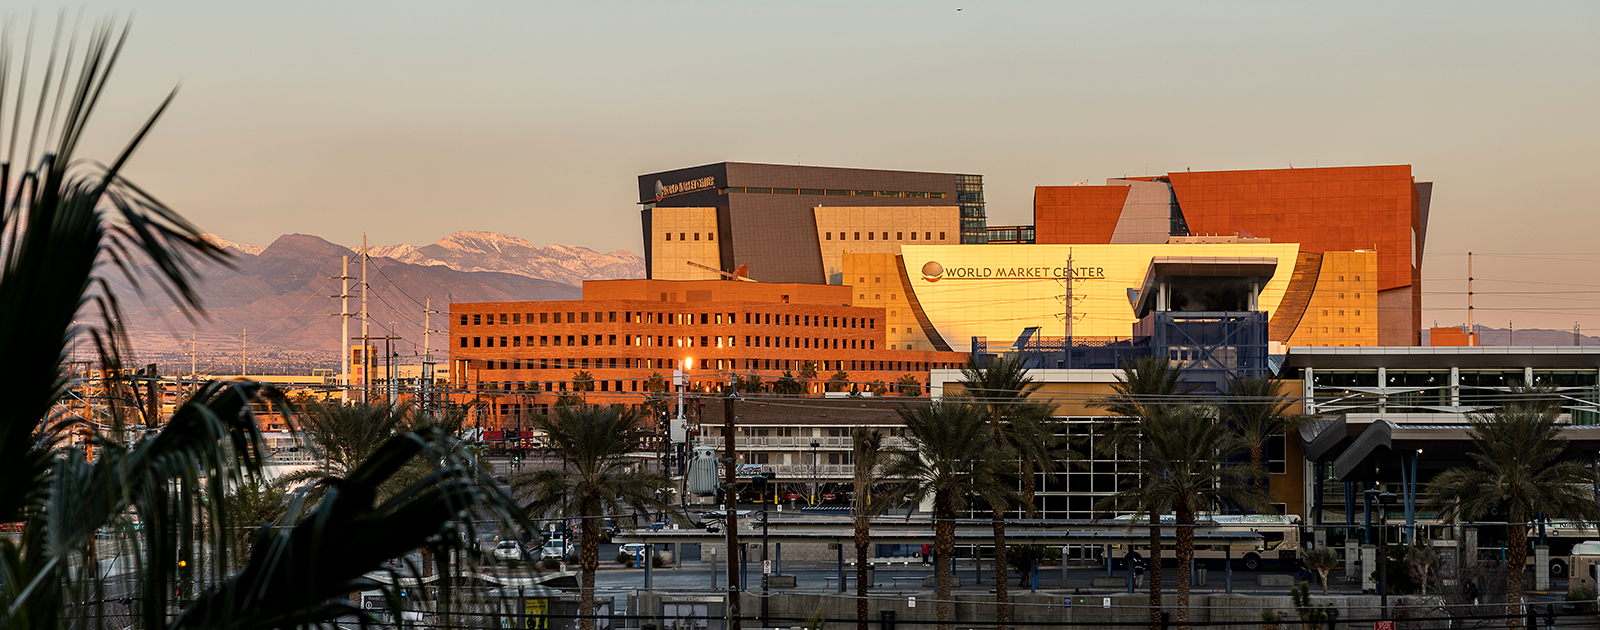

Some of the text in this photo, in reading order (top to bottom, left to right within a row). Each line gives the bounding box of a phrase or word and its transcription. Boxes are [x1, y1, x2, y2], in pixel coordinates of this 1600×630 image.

[945, 267, 1104, 277] WORLD MARKET CENTER
